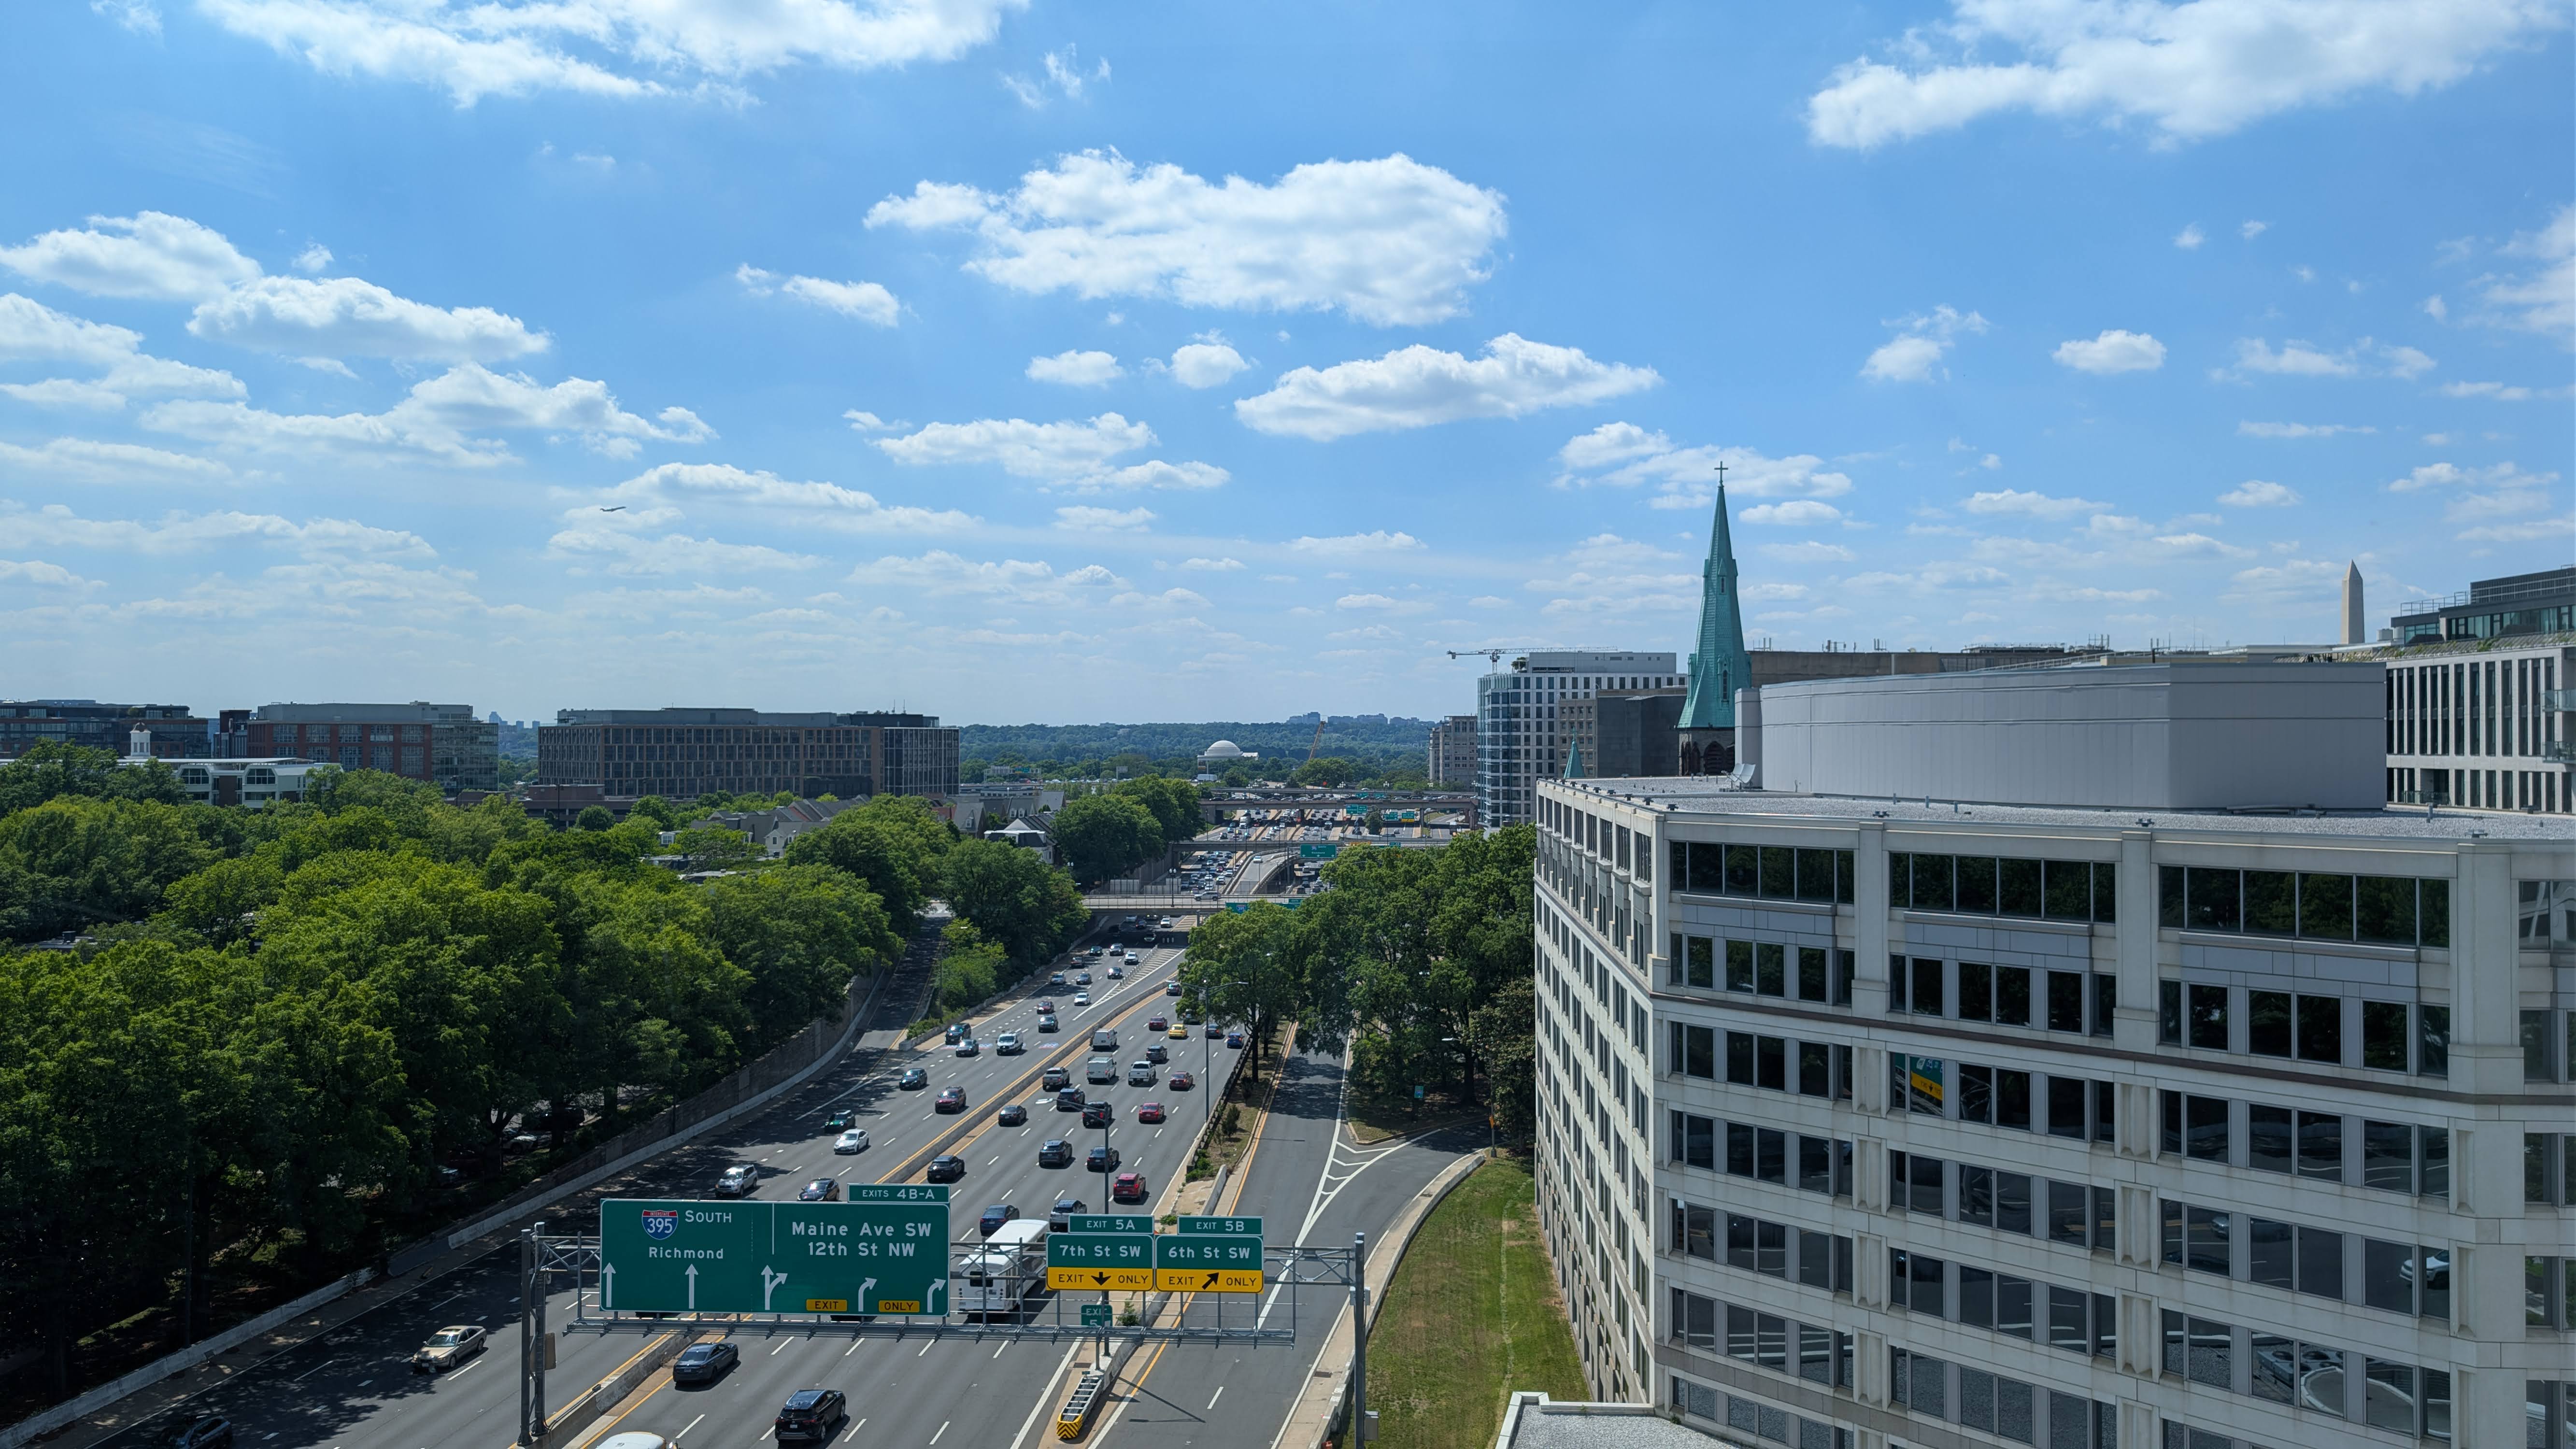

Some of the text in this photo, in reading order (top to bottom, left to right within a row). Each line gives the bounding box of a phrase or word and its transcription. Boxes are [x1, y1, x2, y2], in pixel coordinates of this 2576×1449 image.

[897, 1189, 935, 1199] 4B-A
[685, 1210, 732, 1223] SOUTH
[647, 1218, 673, 1234] 395
[792, 1222, 931, 1236] Maine Ave SW
[1116, 1219, 1135, 1230] 5A
[1225, 1221, 1244, 1232] 5B
[649, 1247, 724, 1259] Richmond
[808, 1242, 915, 1256] 12th St NW
[1059, 1245, 1140, 1257] 7th St SW
[1168, 1246, 1250, 1259] 6th St SW
[1058, 1274, 1148, 1284] EXIT ONLY
[1168, 1276, 1256, 1286] EXIT ONLY
[815, 1301, 914, 1310] EXIT ONLY
